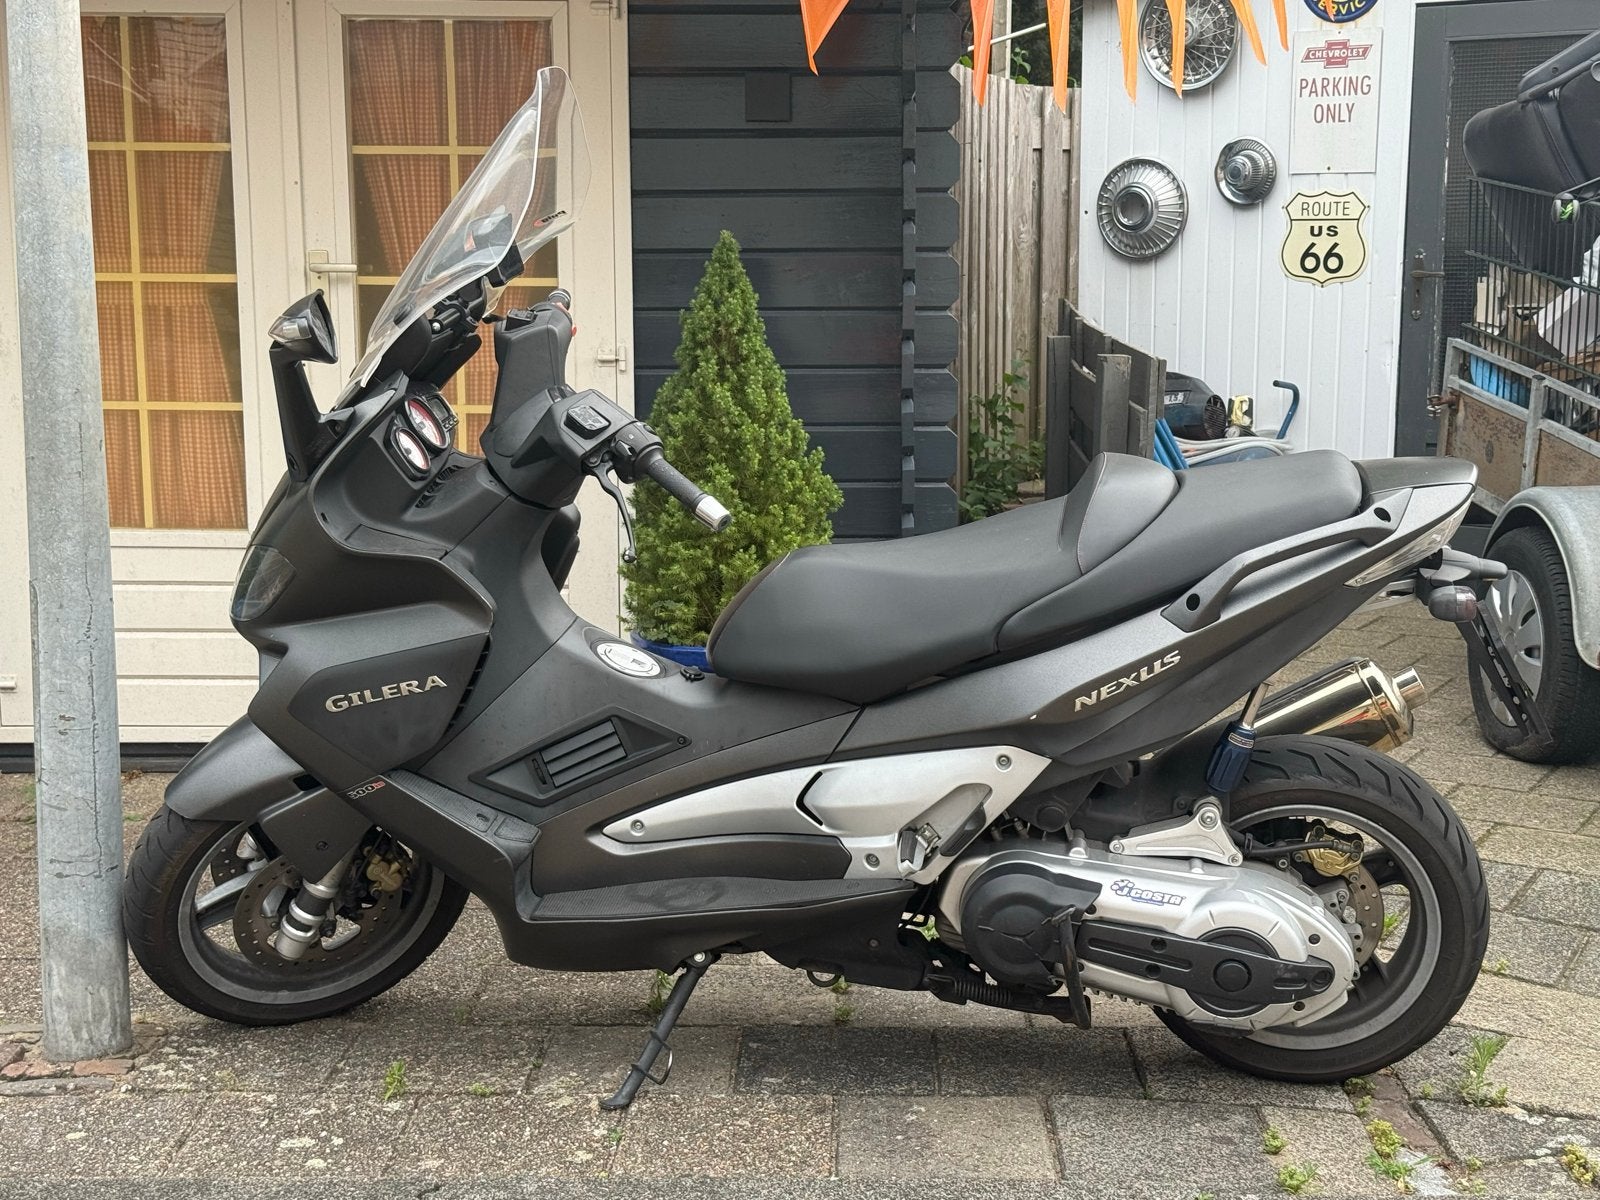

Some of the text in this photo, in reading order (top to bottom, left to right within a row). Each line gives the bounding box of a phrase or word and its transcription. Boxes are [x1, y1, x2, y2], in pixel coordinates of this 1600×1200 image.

[1309, 48, 1365, 59] CHEVROLET
[1299, 75, 1372, 98] PARKING
[1313, 102, 1356, 124] ONLY
[1301, 201, 1351, 217] ROUTE
[1309, 224, 1339, 237] US
[1300, 241, 1344, 274] 66
[1074, 650, 1181, 713] NEXUS
[325, 675, 448, 713] GILERA
